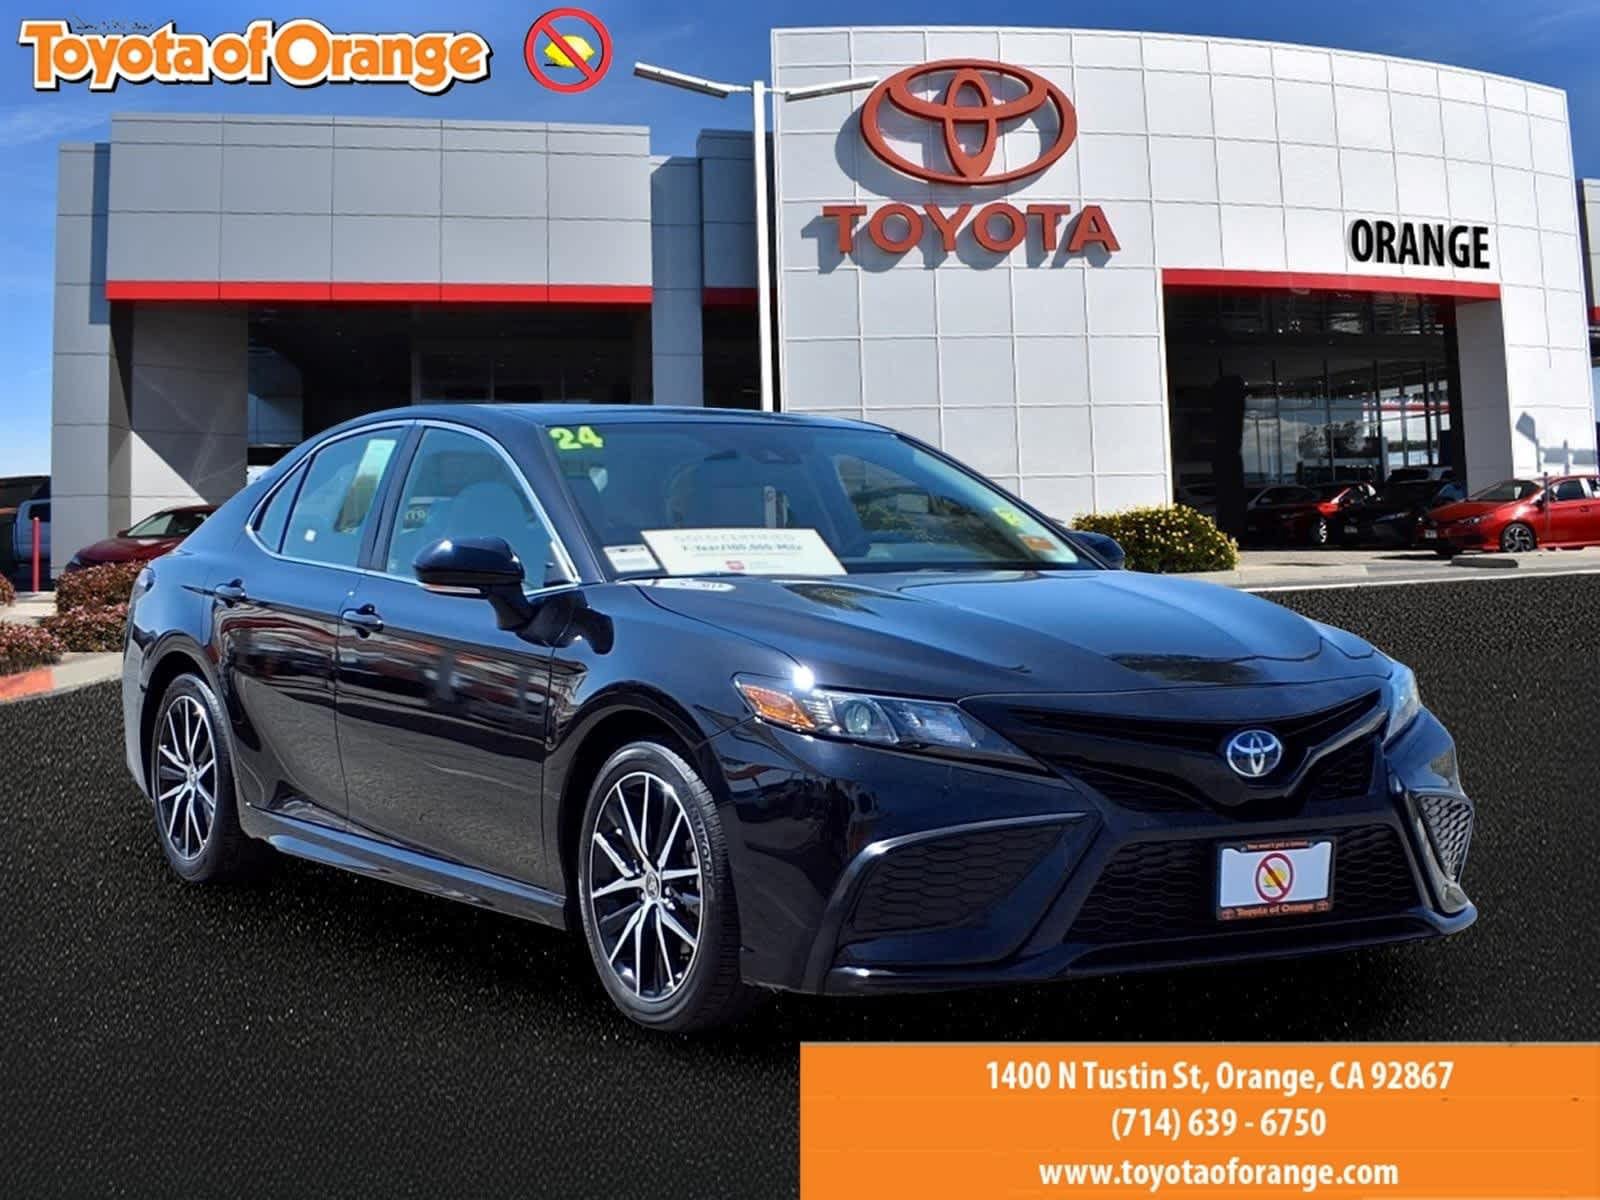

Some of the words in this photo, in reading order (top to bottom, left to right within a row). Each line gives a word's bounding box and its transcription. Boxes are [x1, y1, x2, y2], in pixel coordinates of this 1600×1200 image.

[823, 203, 1120, 254] TOYOTA
[1351, 219, 1491, 269] ORANGE
[549, 425, 603, 449] 24
